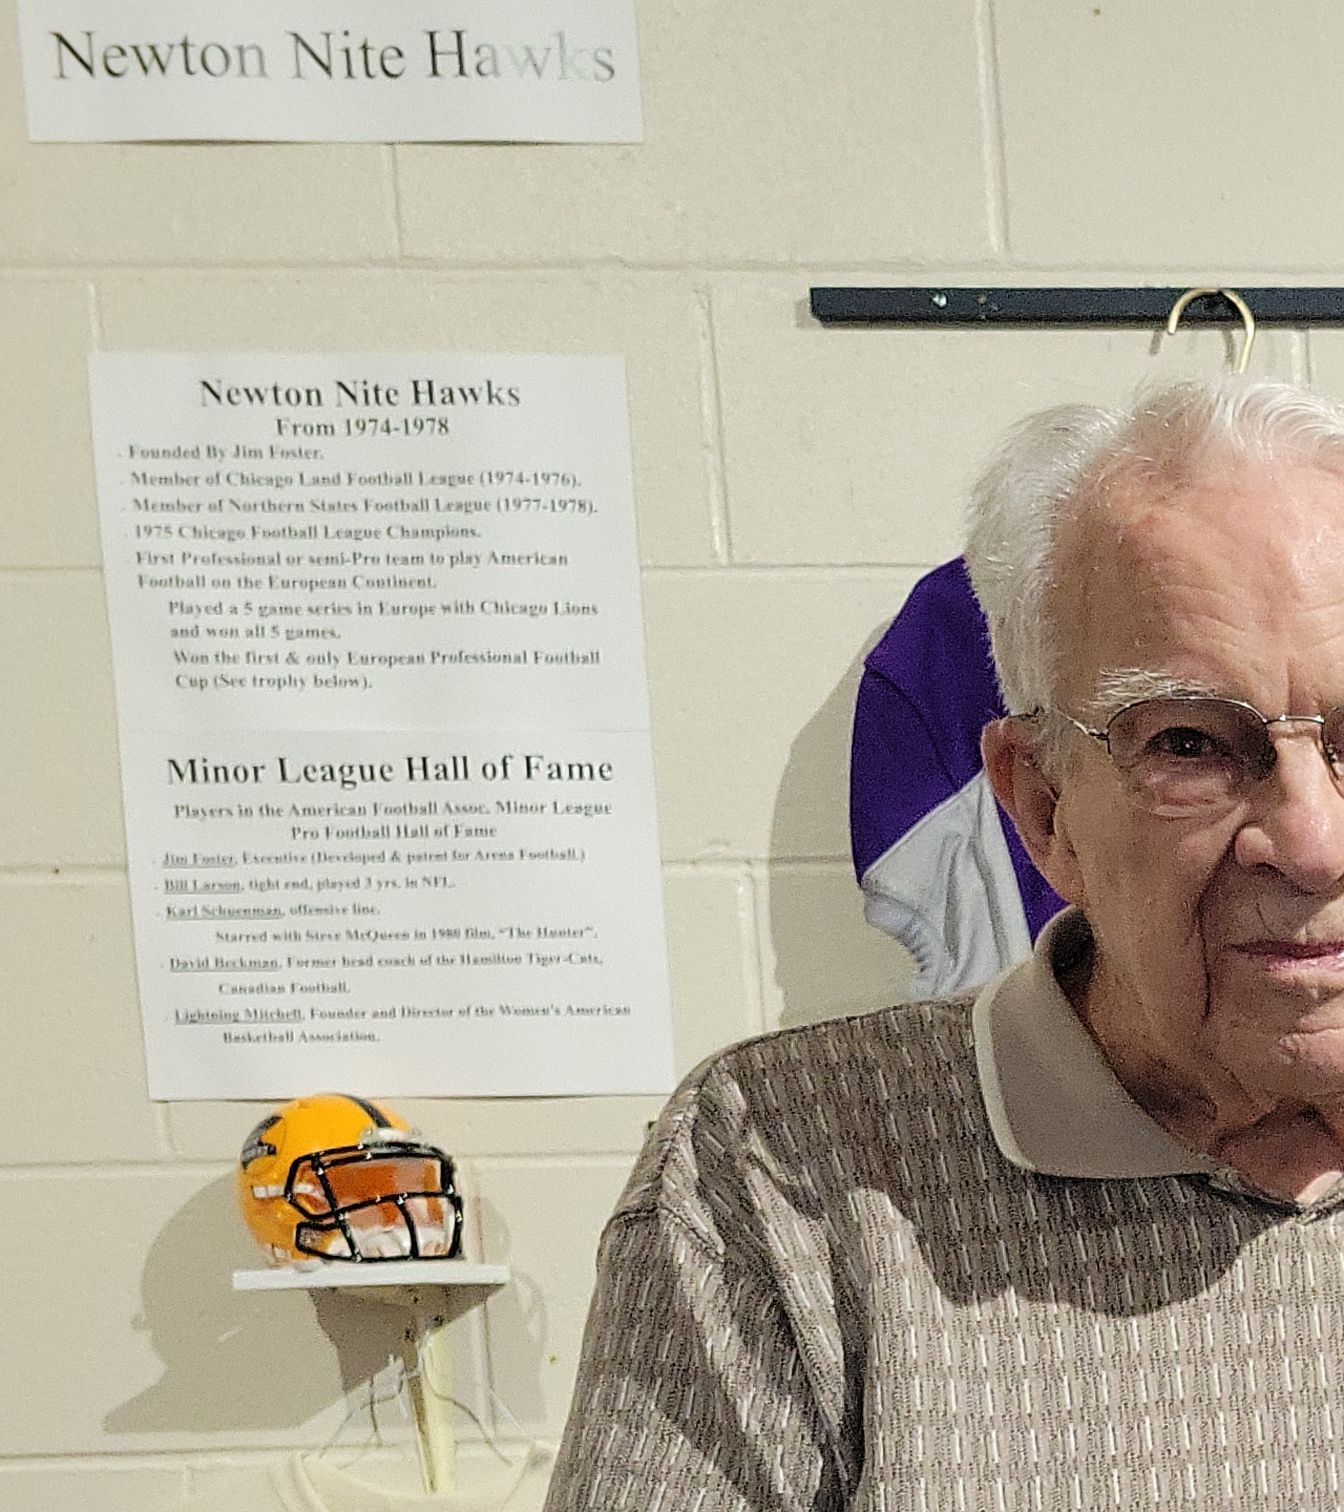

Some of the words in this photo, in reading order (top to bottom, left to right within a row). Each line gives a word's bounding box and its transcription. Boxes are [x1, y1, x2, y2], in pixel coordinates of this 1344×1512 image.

[49, 31, 268, 80] Newton
[284, 30, 406, 79] Nite
[425, 29, 615, 82] Hawks
[201, 381, 322, 406] Newton
[336, 380, 398, 406] Nite
[412, 380, 520, 405] Hawks
[276, 419, 335, 436] From
[345, 418, 449, 435] 1974-1978
[128, 444, 202, 460] Founded
[205, 443, 227, 463] By
[233, 444, 264, 460] Jim
[268, 444, 323, 460] Foster.
[130, 471, 200, 487] Member
[204, 471, 222, 487] of
[225, 471, 294, 489] Chicago
[298, 471, 342, 487] Land
[346, 471, 414, 488] Football
[417, 470, 475, 488] League
[478, 470, 581, 488] (1974-1976).
[132, 497, 202, 513] Member
[207, 498, 224, 513] of
[228, 498, 305, 513] Northern
[362, 497, 431, 514] Football
[433, 497, 492, 514] League
[134, 524, 173, 539] 1975
[177, 524, 246, 543] Chicago
[250, 524, 319, 540] Football
[322, 524, 382, 542] League
[135, 551, 175, 565] First
[180, 550, 282, 567] Professional
[285, 555, 303, 567] or
[384, 553, 426, 566] team
[428, 553, 446, 566] to
[448, 550, 482, 569] play
[487, 550, 569, 566] American
[137, 574, 207, 589] Football
[210, 578, 232, 589] on
[236, 575, 263, 590] the
[267, 575, 348, 593] European
[167, 600, 224, 619] Played
[228, 605, 239, 616] a
[242, 600, 256, 617] 5
[257, 605, 302, 618] game
[356, 601, 374, 616] in
[377, 601, 437, 619] Europe
[440, 599, 476, 615] with
[479, 600, 549, 618] Chicago
[552, 601, 599, 616] Lions
[169, 624, 201, 639] and
[205, 627, 240, 639] won
[244, 624, 267, 639] all
[270, 624, 281, 639] 5
[172, 649, 210, 665] Won
[213, 650, 240, 665] the
[244, 650, 280, 665] first
[284, 651, 300, 666] &
[305, 649, 341, 669] only
[346, 651, 426, 669] European
[429, 649, 529, 665] Professional
[532, 650, 601, 665] Football
[174, 674, 209, 692] Cup
[251, 673, 307, 692] trophy
[167, 757, 265, 785] Minor
[279, 758, 392, 790] League
[407, 756, 469, 781] Hall
[481, 755, 511, 782] of
[525, 755, 612, 781] Fame
[173, 802, 235, 822] Players
[237, 804, 254, 819] in
[257, 803, 284, 818] the
[288, 802, 368, 817] American
[372, 800, 439, 816] Football
[494, 799, 546, 815] Minor
[551, 800, 613, 818] League
[290, 826, 320, 841] Pro
[324, 824, 392, 840] Football
[395, 823, 430, 839] Hall
[433, 824, 449, 838] of
[453, 823, 497, 839] Fame
[371, 1006, 398, 1020] and
[457, 1005, 472, 1018] of
[473, 1005, 496, 1017] the
